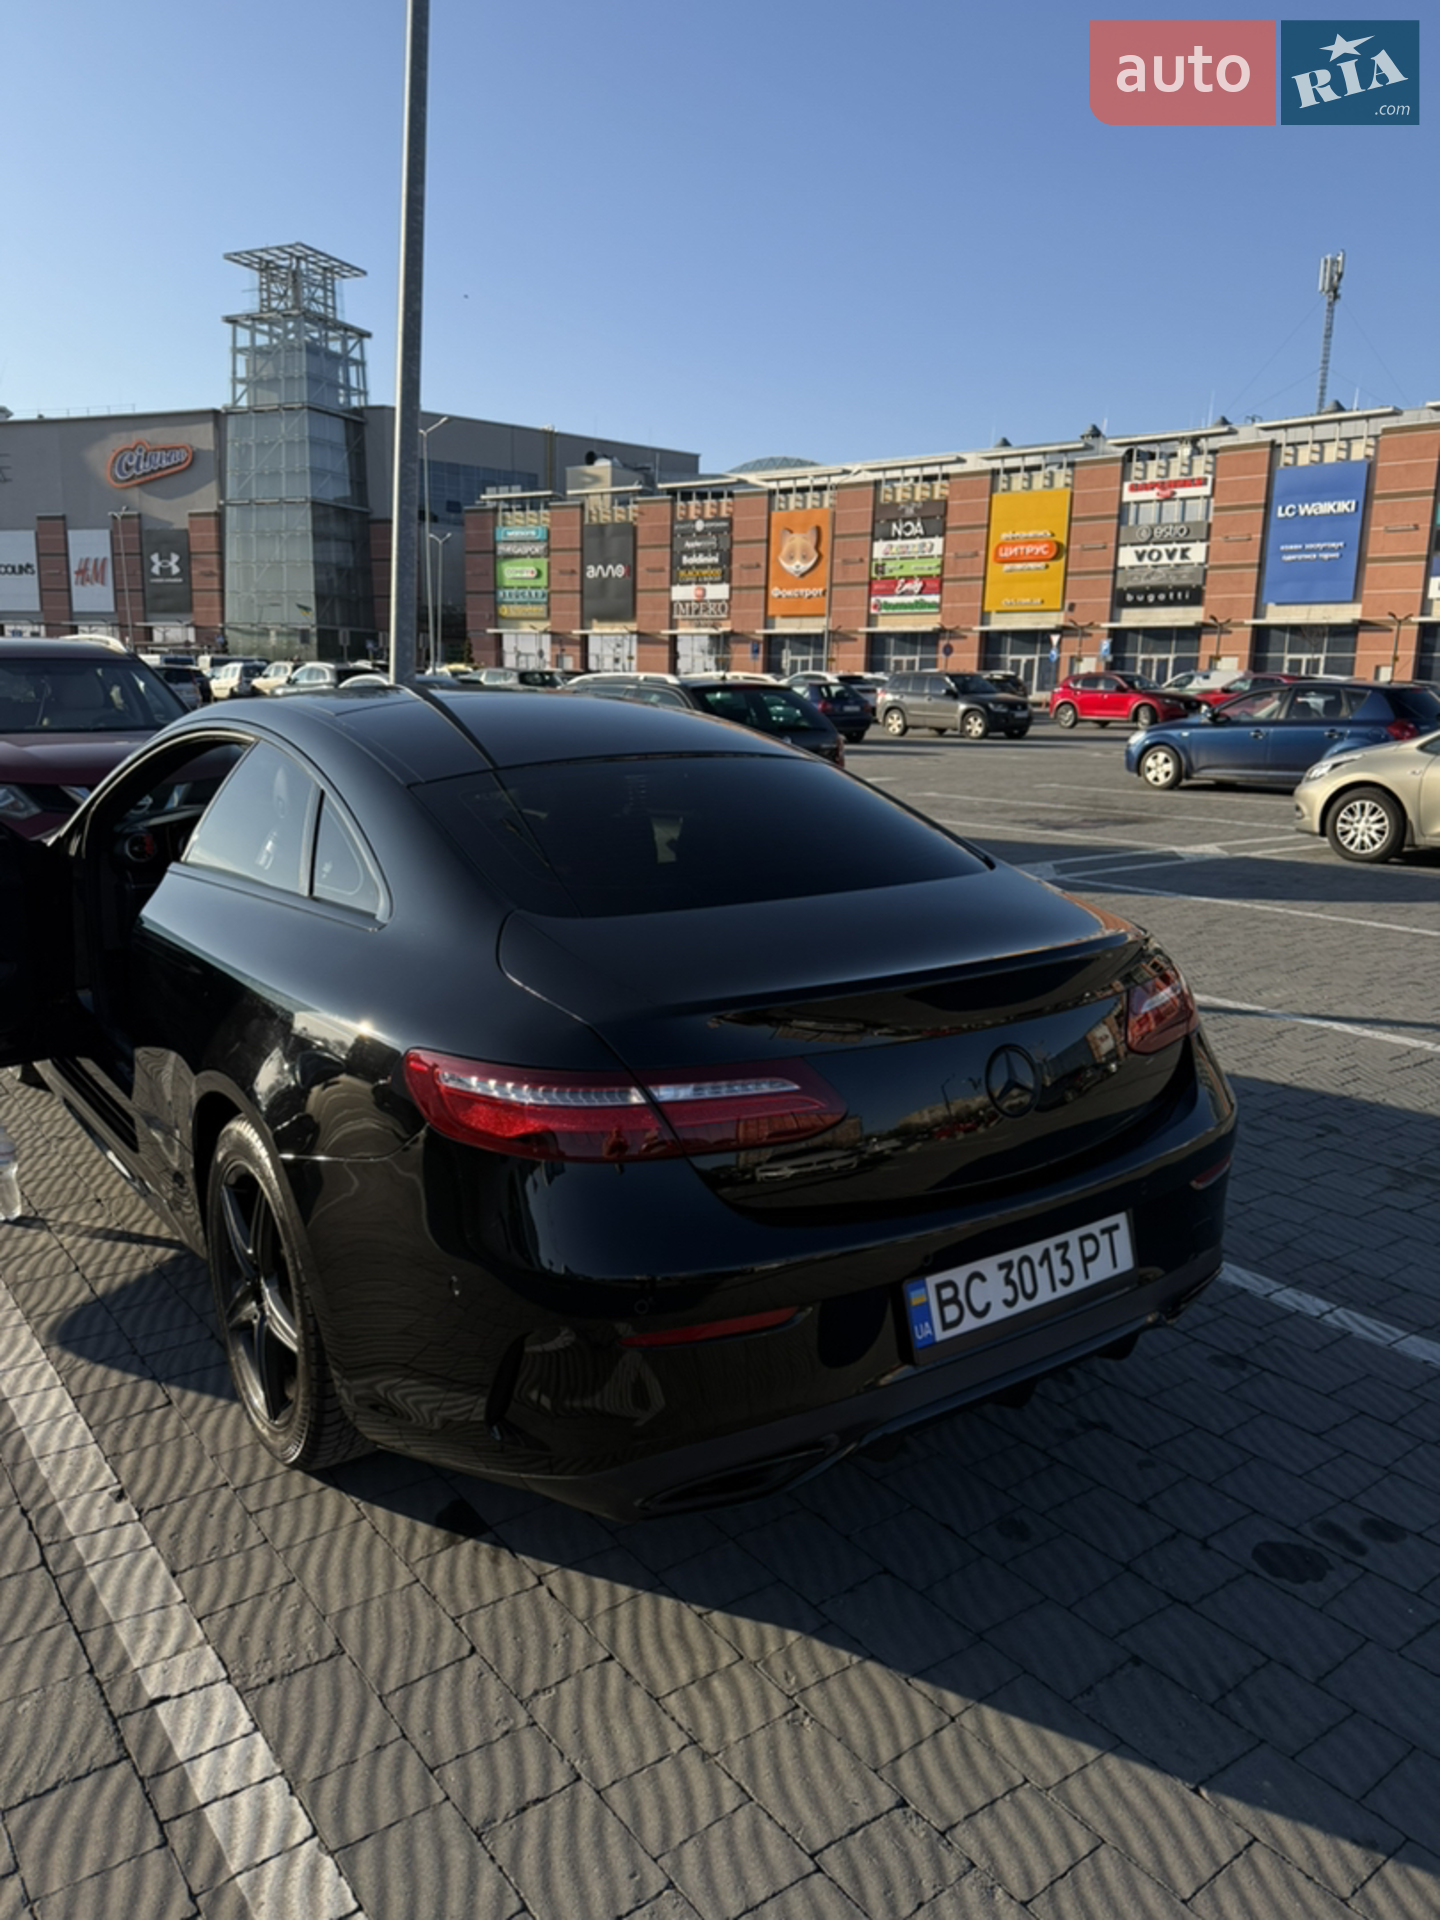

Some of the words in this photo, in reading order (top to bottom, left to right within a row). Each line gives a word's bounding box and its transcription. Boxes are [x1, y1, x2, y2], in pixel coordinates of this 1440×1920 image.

[1277, 504, 1296, 518] LC
[998, 544, 1050, 558] ЦИТРУС
[1134, 547, 1192, 562] VOVK
[74, 557, 108, 588] H&M
[771, 587, 825, 599] Фокстрот
[1126, 591, 1190, 603] bugatti
[935, 1271, 992, 1332] BC
[997, 1240, 1074, 1308] 3013
[1078, 1223, 1121, 1280] PT
[914, 1322, 934, 1340] UA
